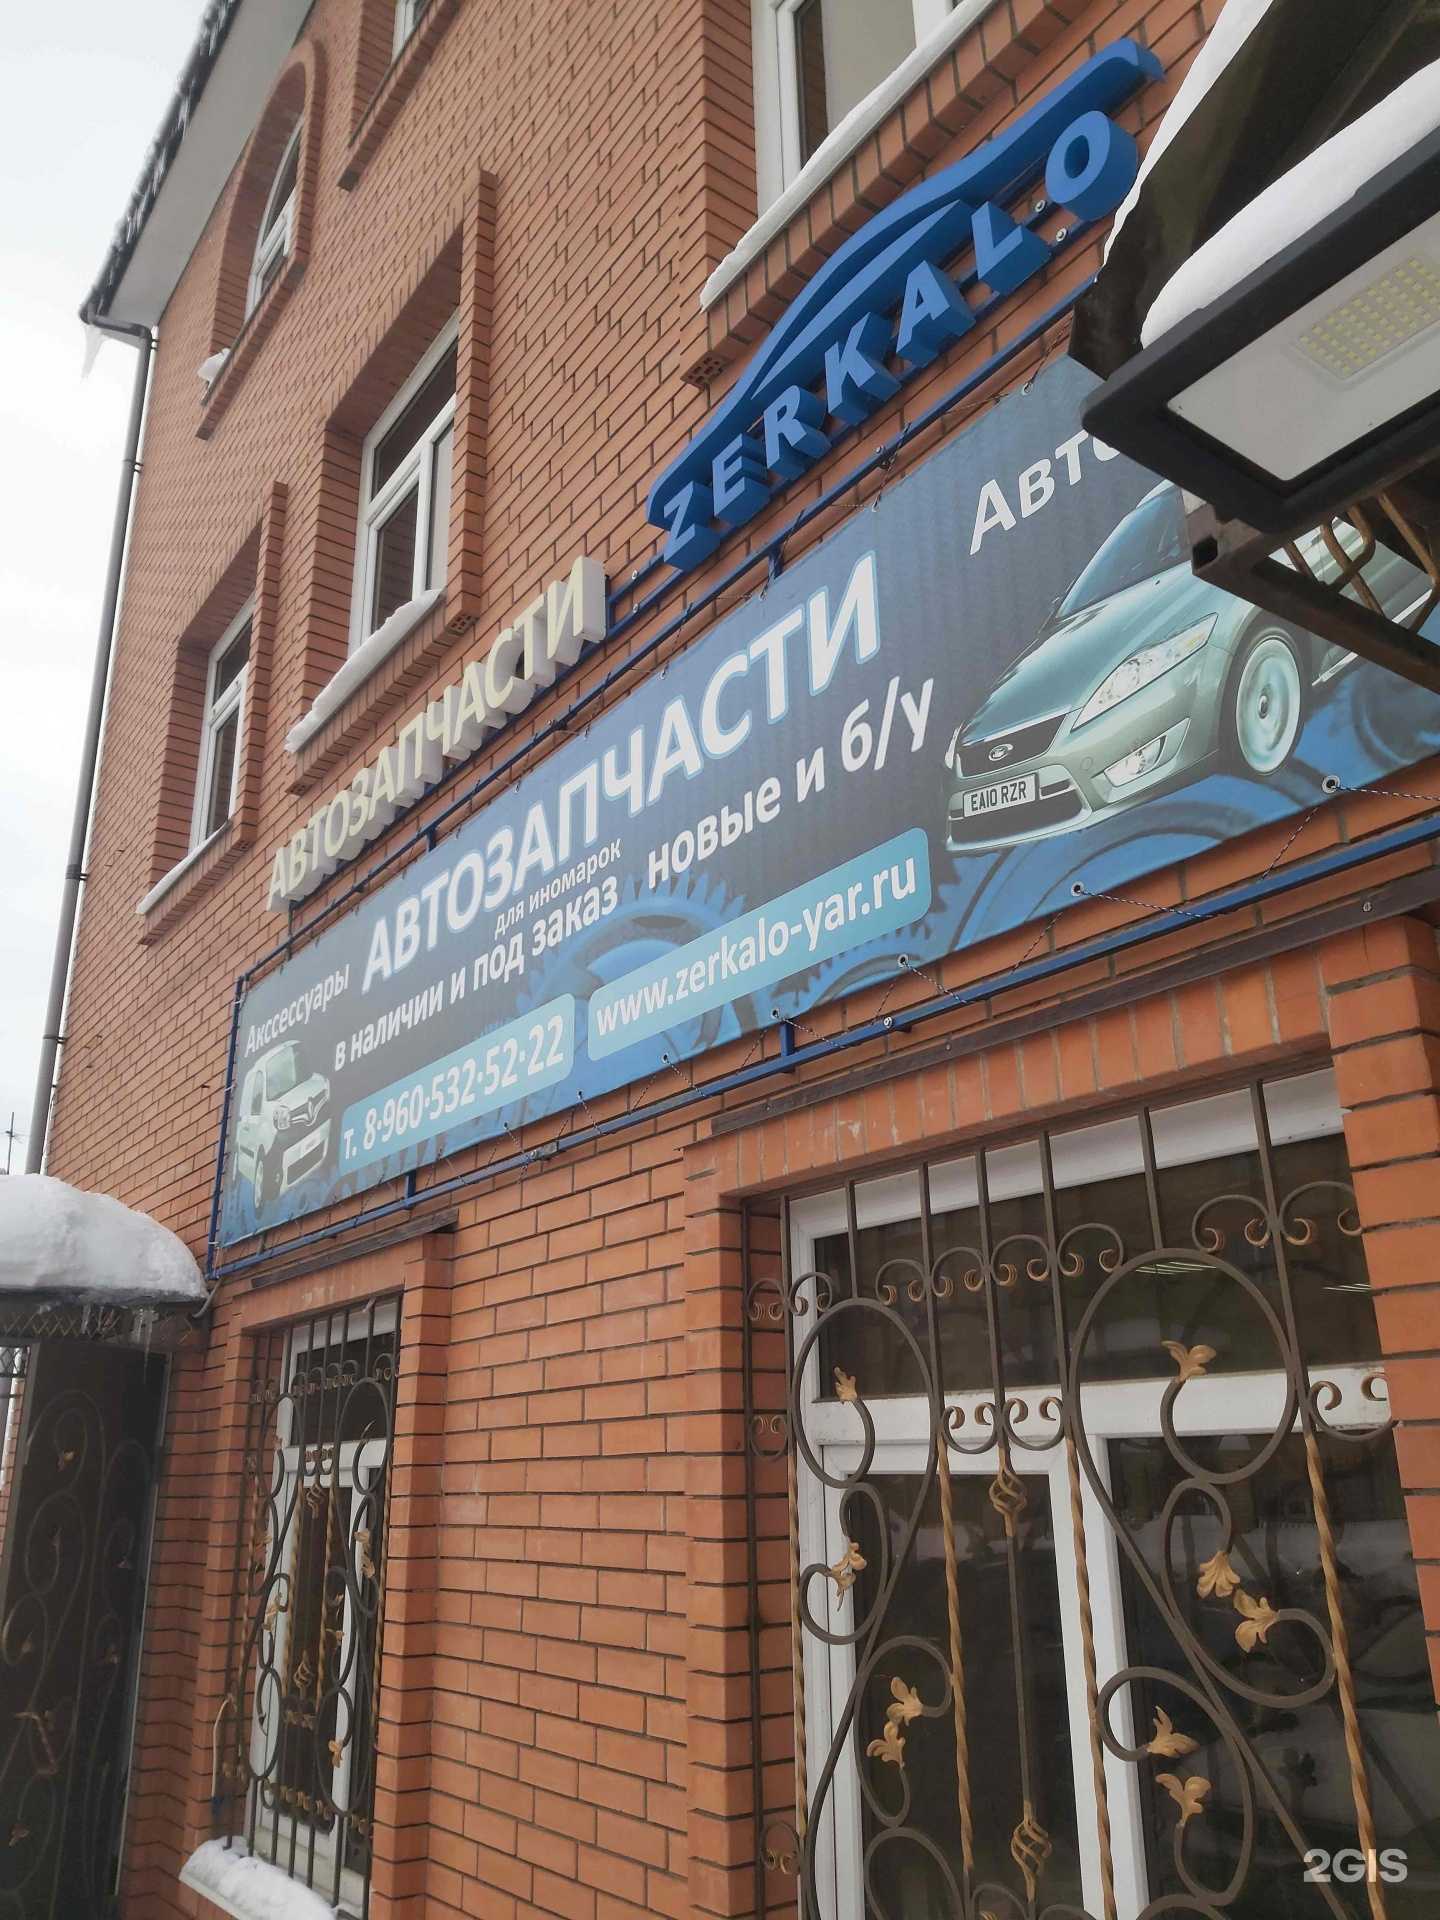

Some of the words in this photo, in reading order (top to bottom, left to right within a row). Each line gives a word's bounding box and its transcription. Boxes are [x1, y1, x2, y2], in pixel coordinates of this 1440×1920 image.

[663, 111, 1118, 558] ZERKALO
[267, 556, 598, 910] АВТОЗАПЧАСТИ
[335, 1040, 346, 1072] в
[350, 978, 444, 1064] наличии
[450, 966, 466, 1004] и
[473, 932, 525, 991] под
[532, 875, 618, 956] заказ
[648, 777, 781, 889] новые
[795, 746, 826, 803] и
[841, 675, 935, 773] б/у
[361, 550, 880, 996] АВТОЗАПЧАСТИ
[494, 900, 525, 940] для
[529, 838, 622, 913] иномарок
[1001, 780, 1027, 804] RZR
[596, 856, 916, 1037] www.zerkalo-yar.ru
